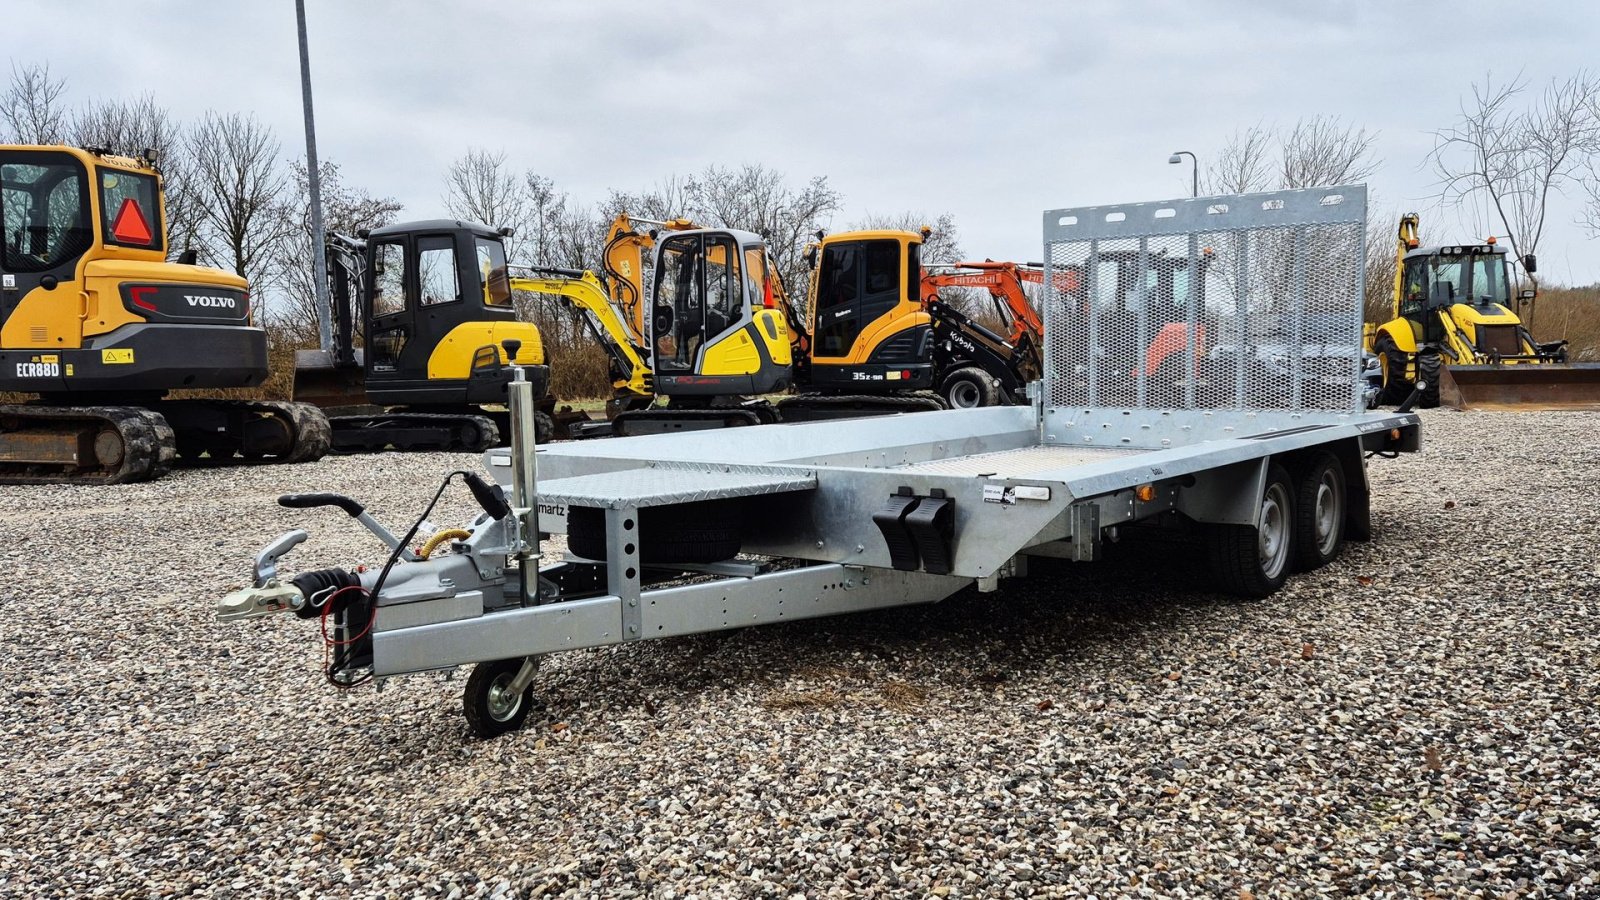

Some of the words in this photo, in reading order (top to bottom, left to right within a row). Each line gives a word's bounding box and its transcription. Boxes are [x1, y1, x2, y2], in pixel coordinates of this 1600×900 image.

[102, 158, 141, 170] VOLVO
[954, 275, 996, 285] HITACHI
[183, 295, 236, 309] VOLVO
[949, 331, 975, 353] Kubota
[16, 362, 59, 377] ECR88D
